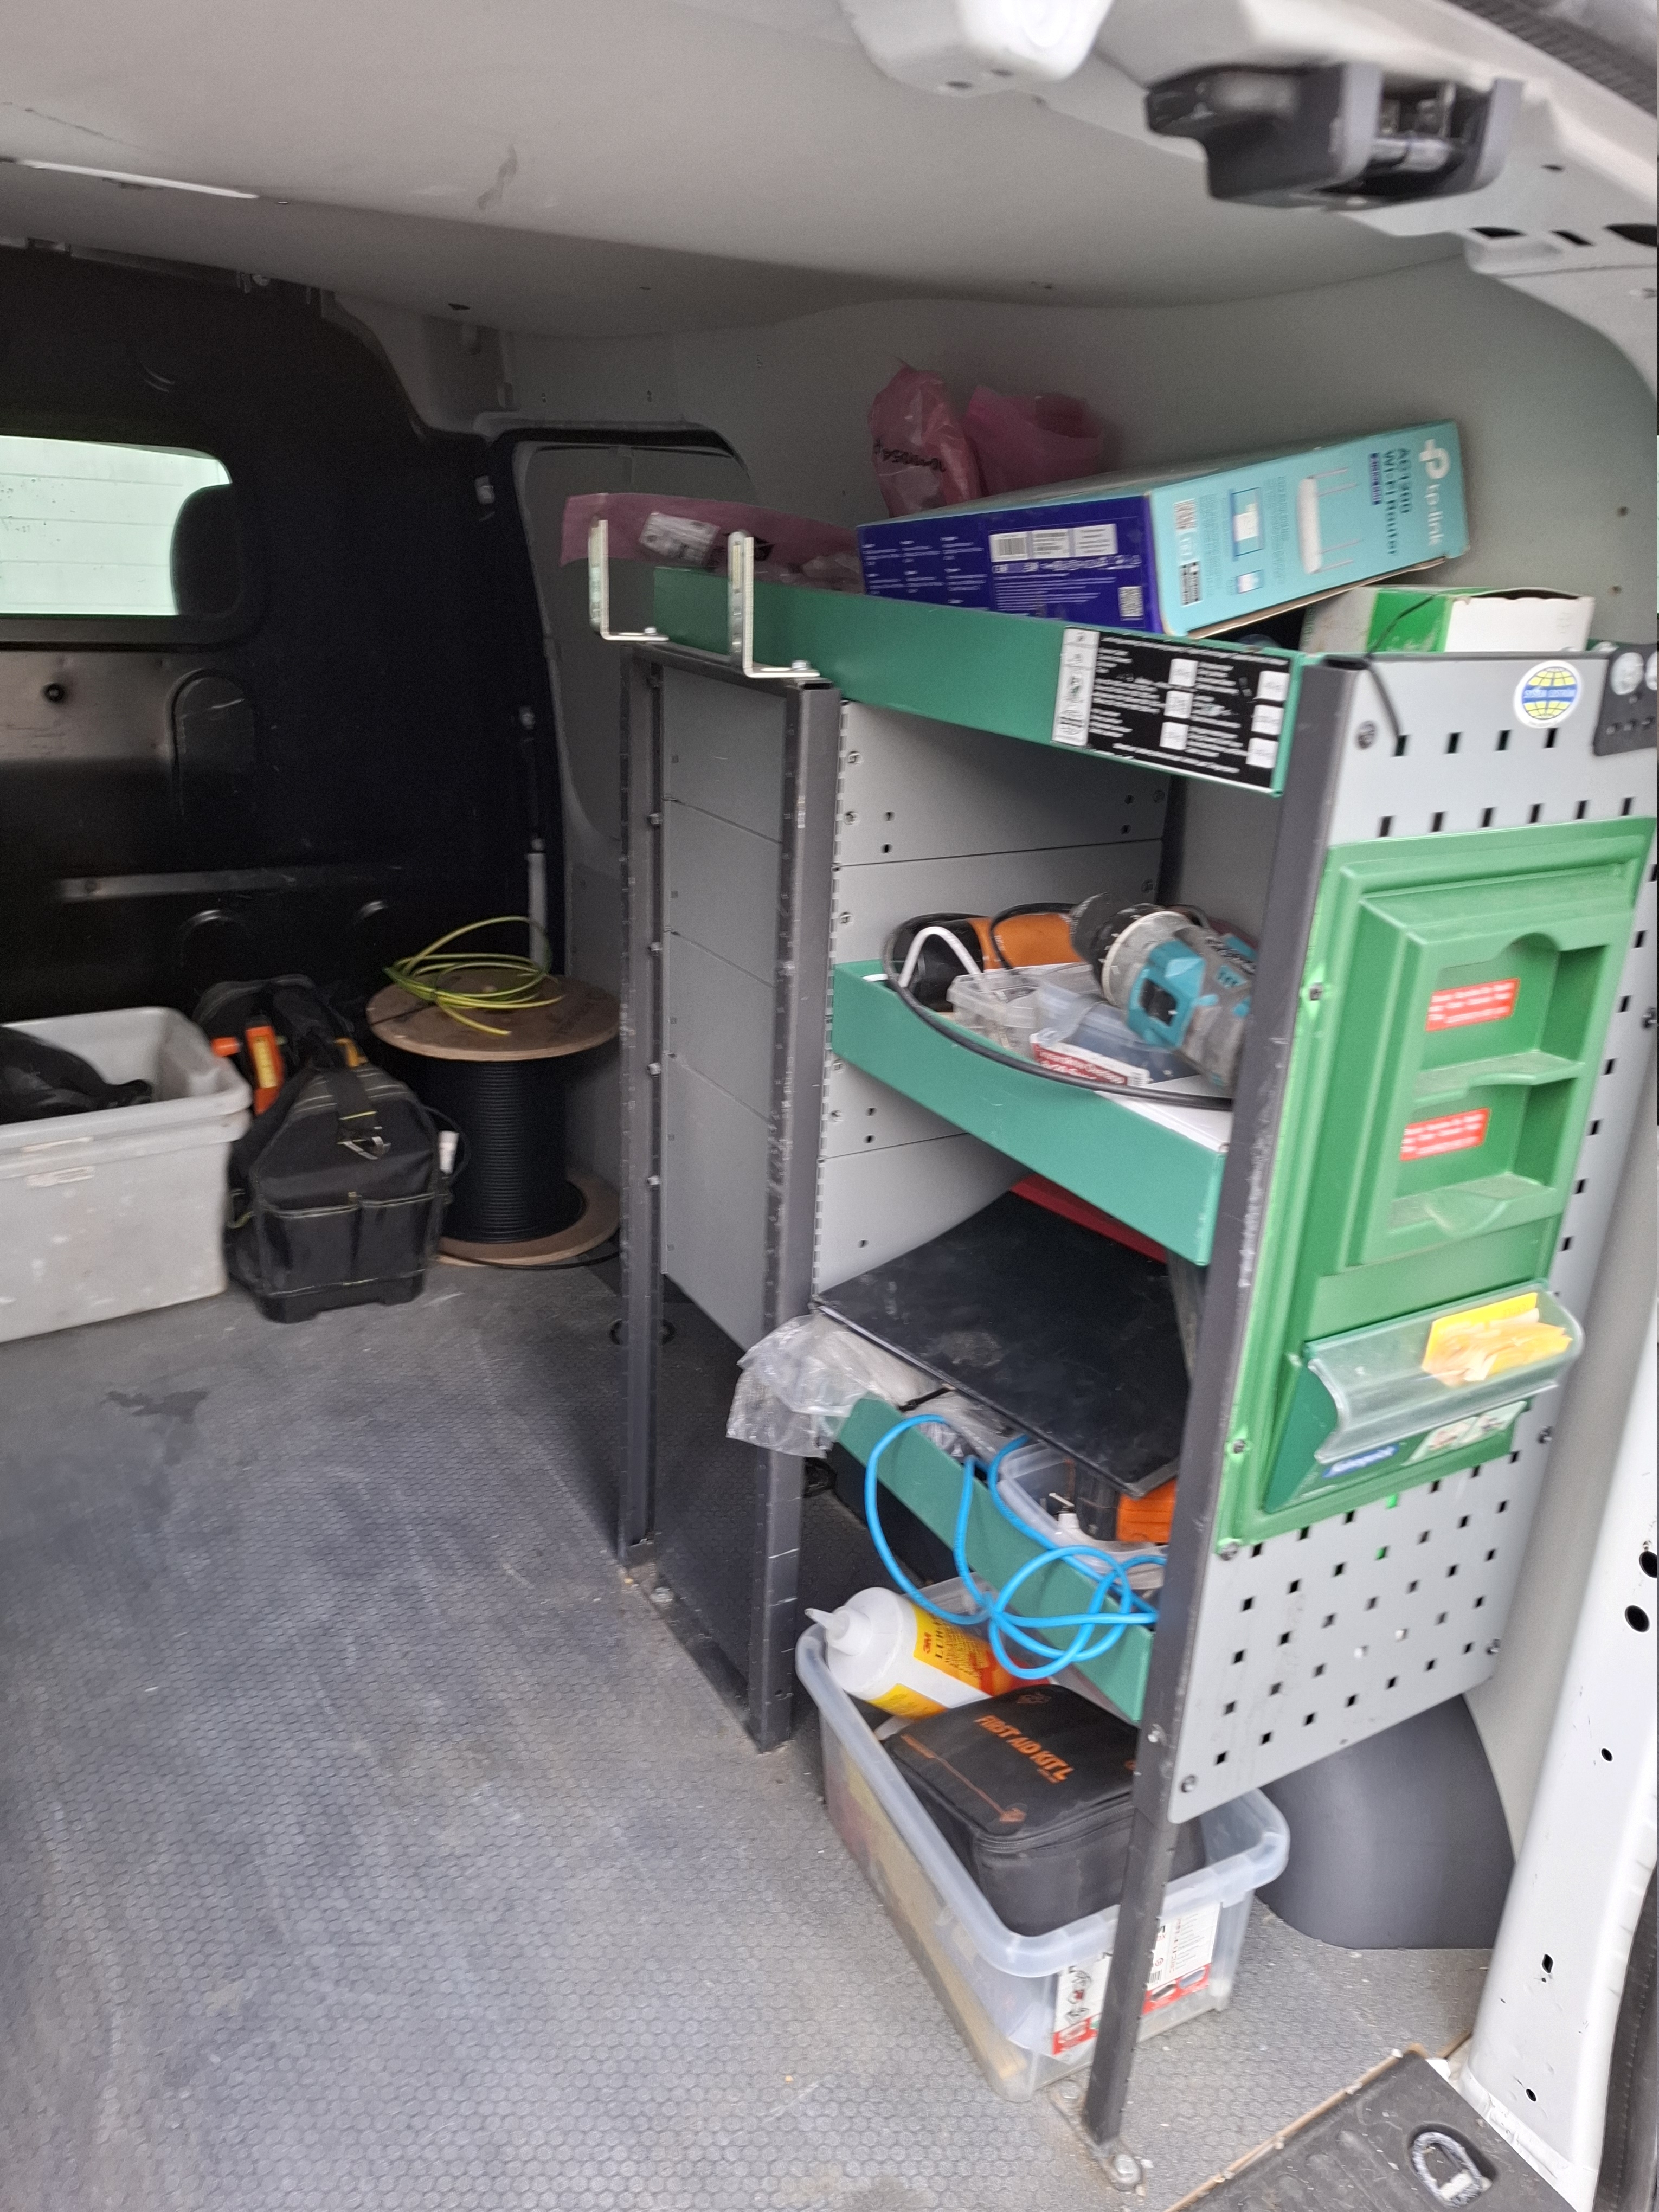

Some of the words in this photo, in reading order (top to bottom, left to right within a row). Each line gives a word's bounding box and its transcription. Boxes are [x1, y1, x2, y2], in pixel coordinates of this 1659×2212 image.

[923, 1632, 932, 1654] 3M
[974, 1715, 1021, 1738] FIRST
[1006, 1737, 1042, 1754] AID
[1029, 1750, 1068, 1770] KIT
